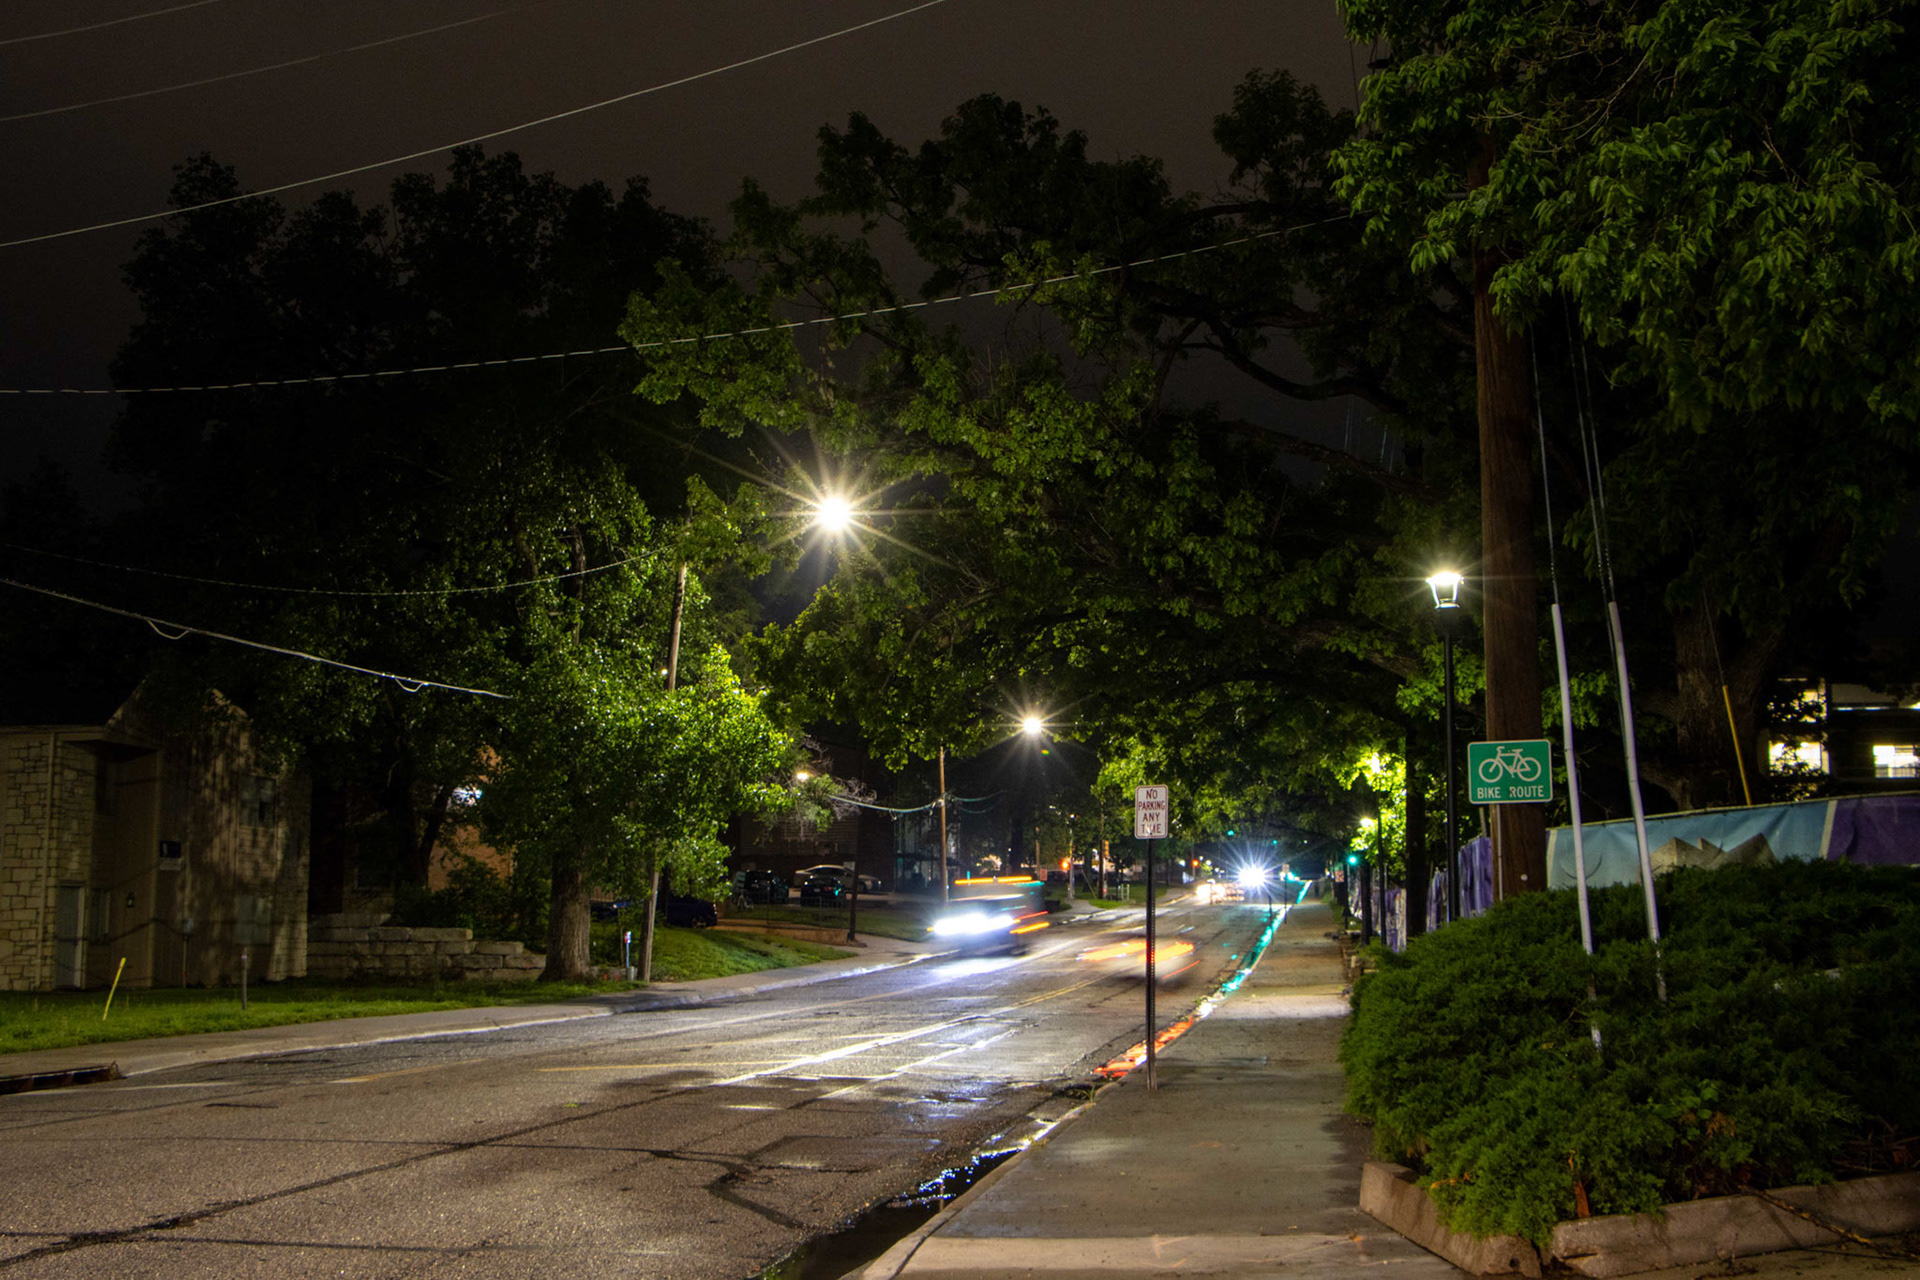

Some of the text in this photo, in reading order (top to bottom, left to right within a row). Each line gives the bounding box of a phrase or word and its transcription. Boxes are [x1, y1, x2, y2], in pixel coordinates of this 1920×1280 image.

[1146, 789, 1158, 799] NO
[1477, 785, 1544, 799] BIKE ROUTE
[1138, 801, 1166, 811] PARKING
[1142, 812, 1160, 822] ANY
[1141, 824, 1161, 834] TME
